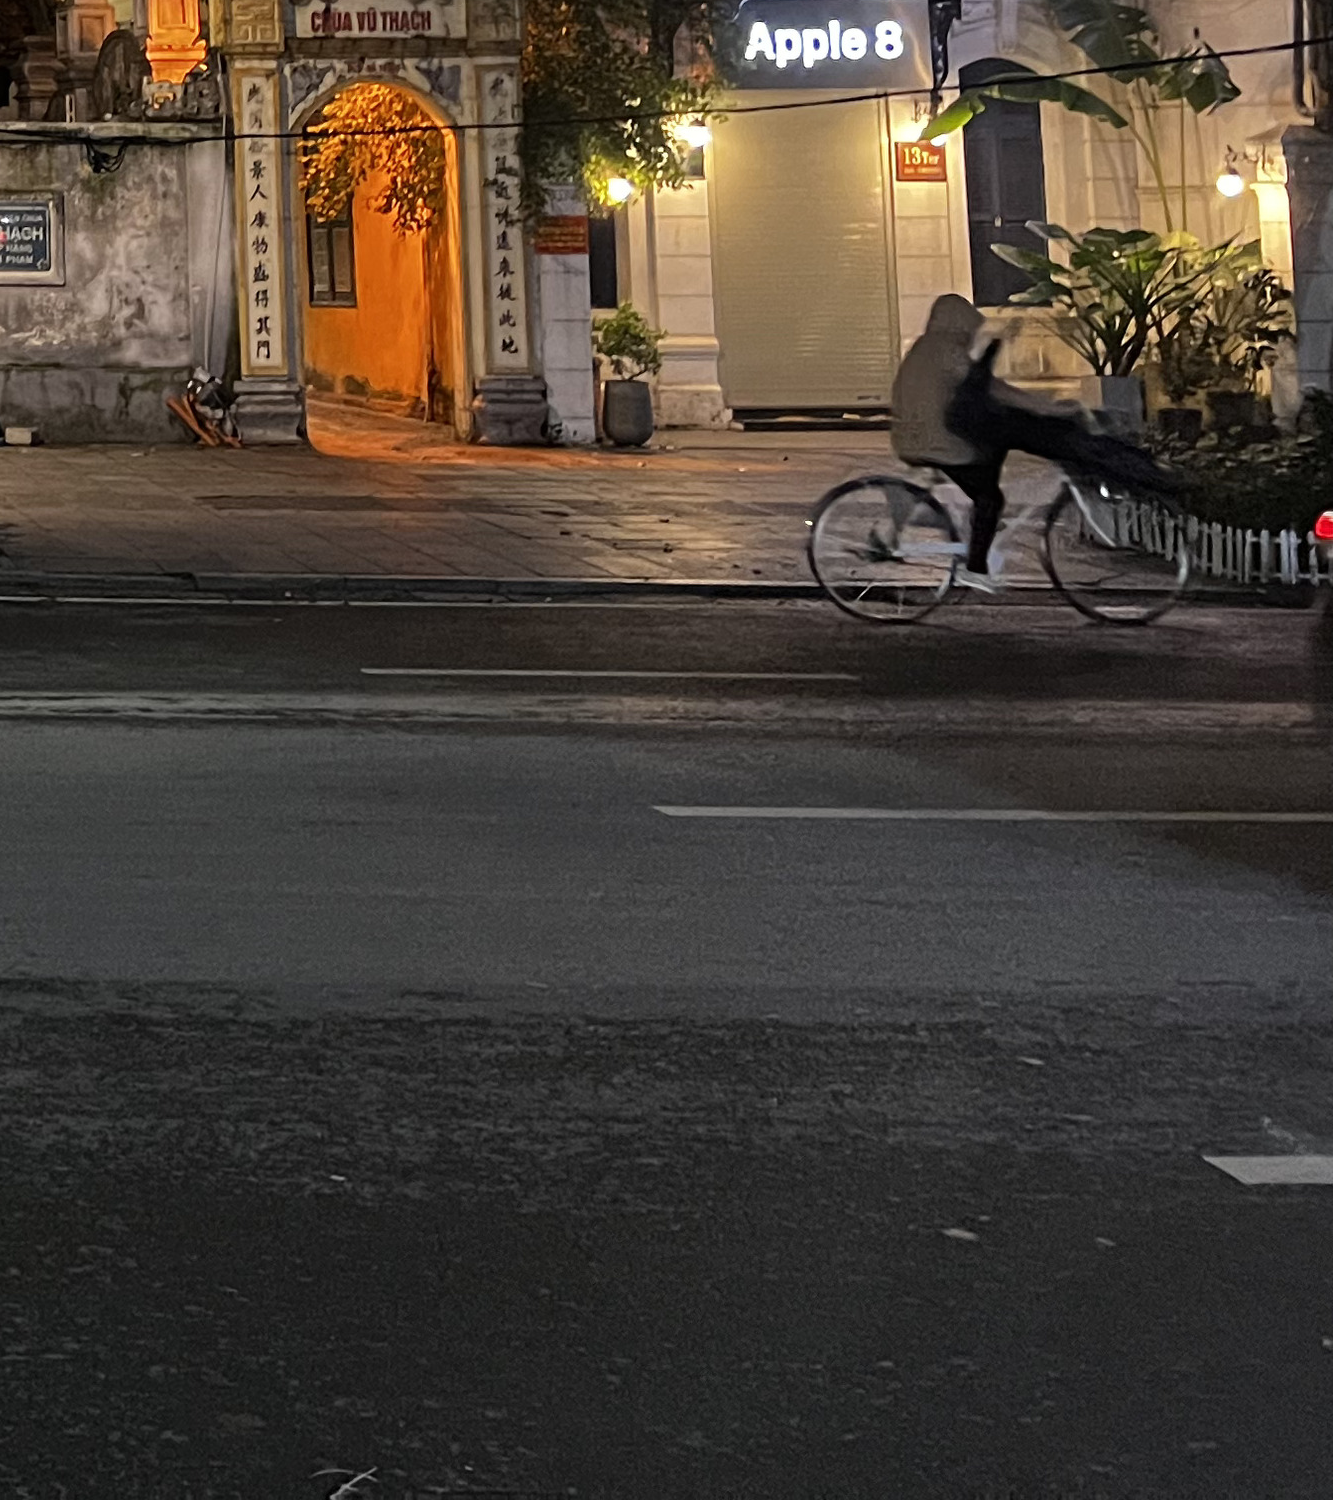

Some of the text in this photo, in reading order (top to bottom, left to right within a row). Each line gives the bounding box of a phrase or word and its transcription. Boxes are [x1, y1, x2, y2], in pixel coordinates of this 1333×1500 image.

[311, 7, 431, 34] CHÙA VŨ THẠCH
[744, 19, 904, 69] Apple 8
